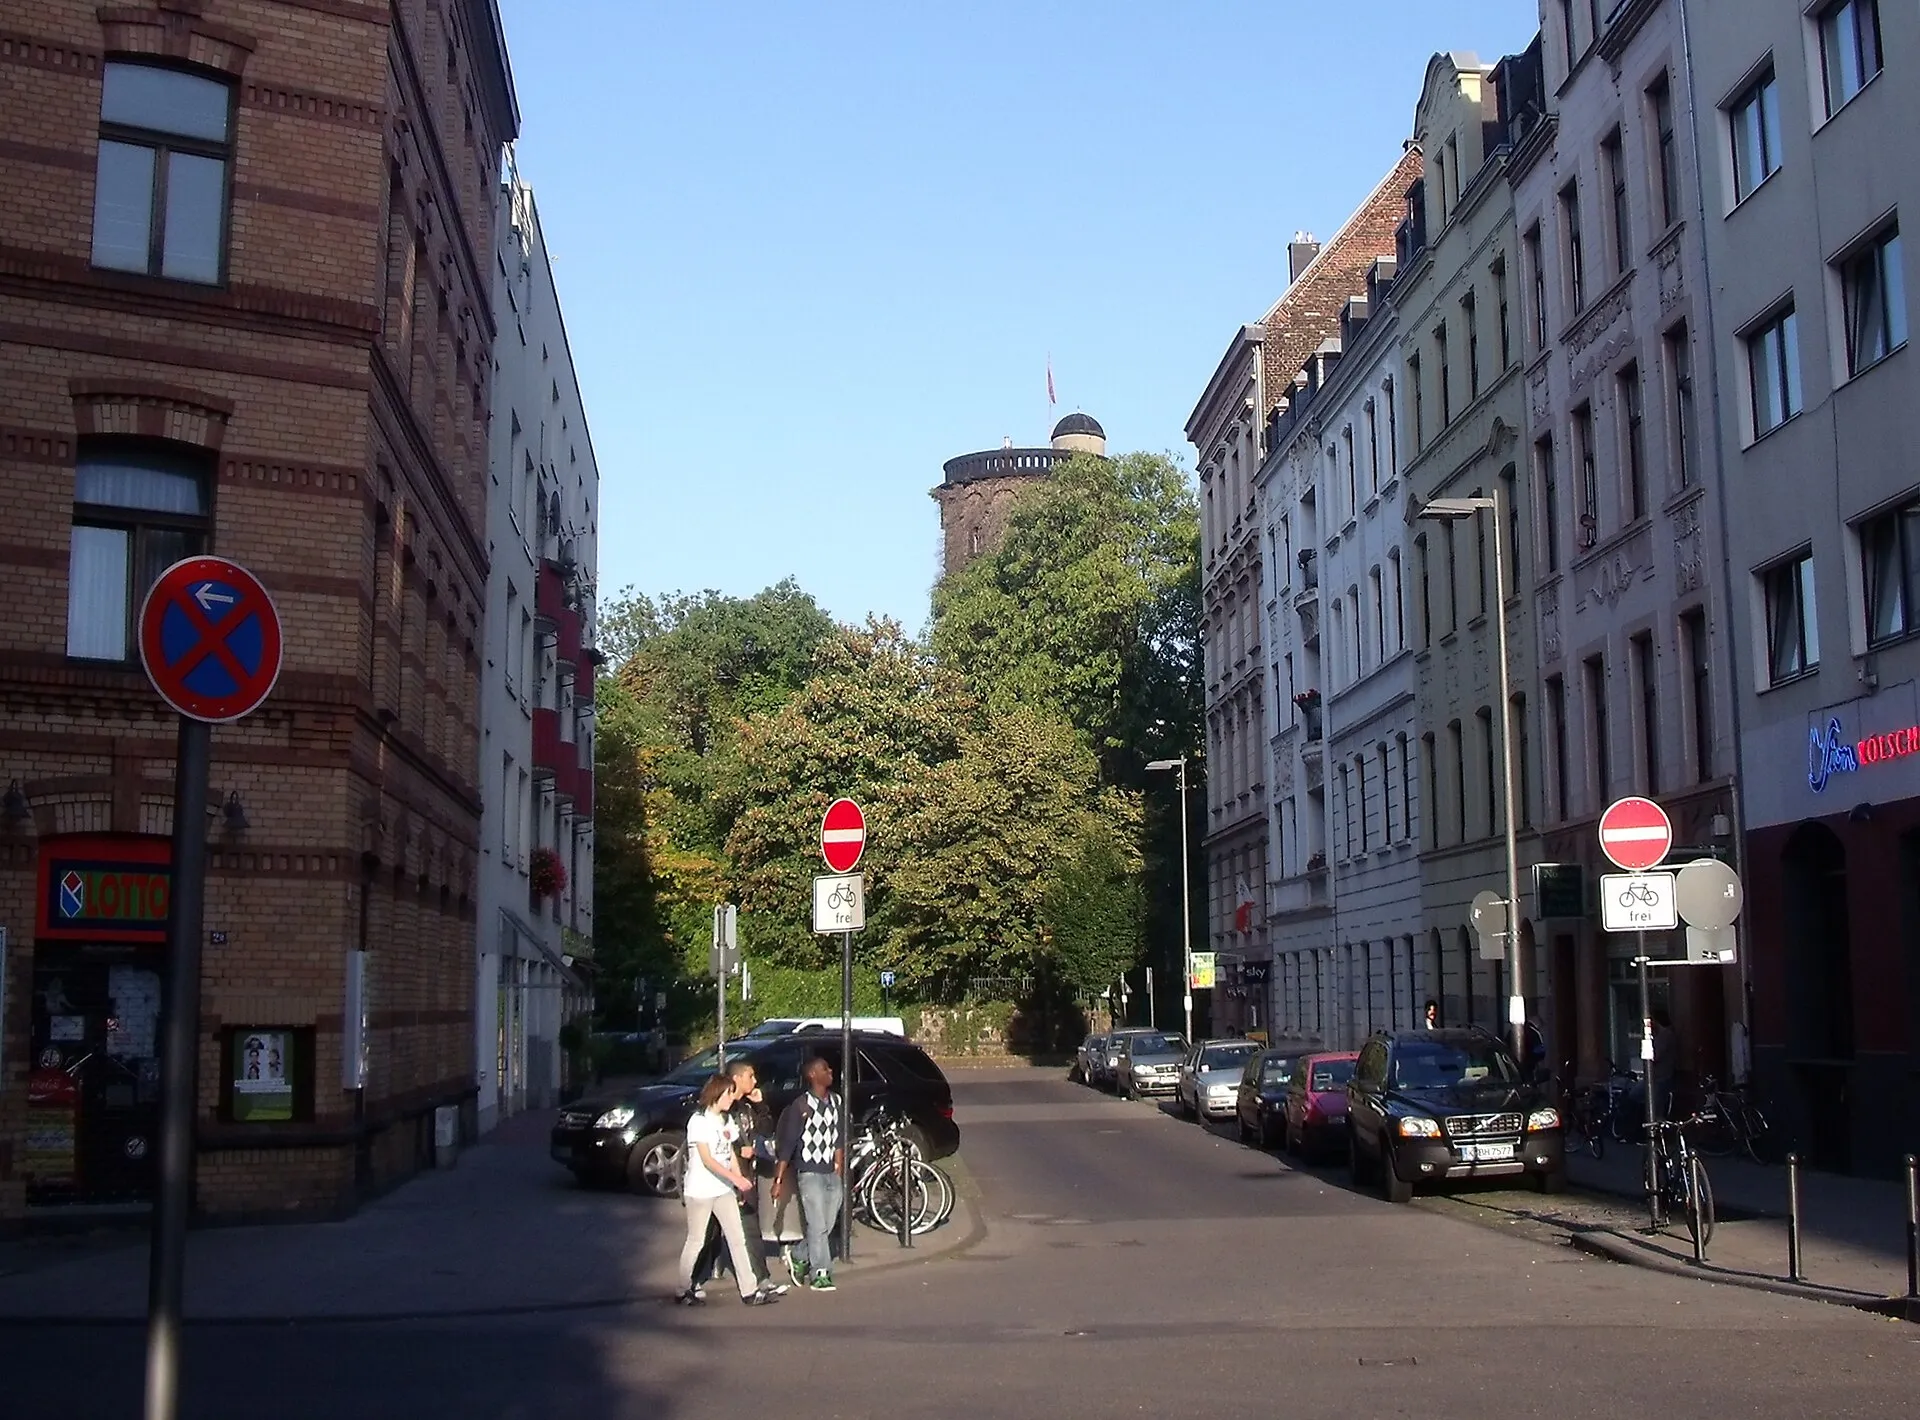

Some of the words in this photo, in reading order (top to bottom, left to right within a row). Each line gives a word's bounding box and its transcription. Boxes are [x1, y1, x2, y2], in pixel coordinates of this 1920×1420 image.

[85, 871, 169, 919] LOTTO
[836, 912, 853, 923] frei
[1630, 910, 1651, 922] frei
[1246, 965, 1266, 979] sky
